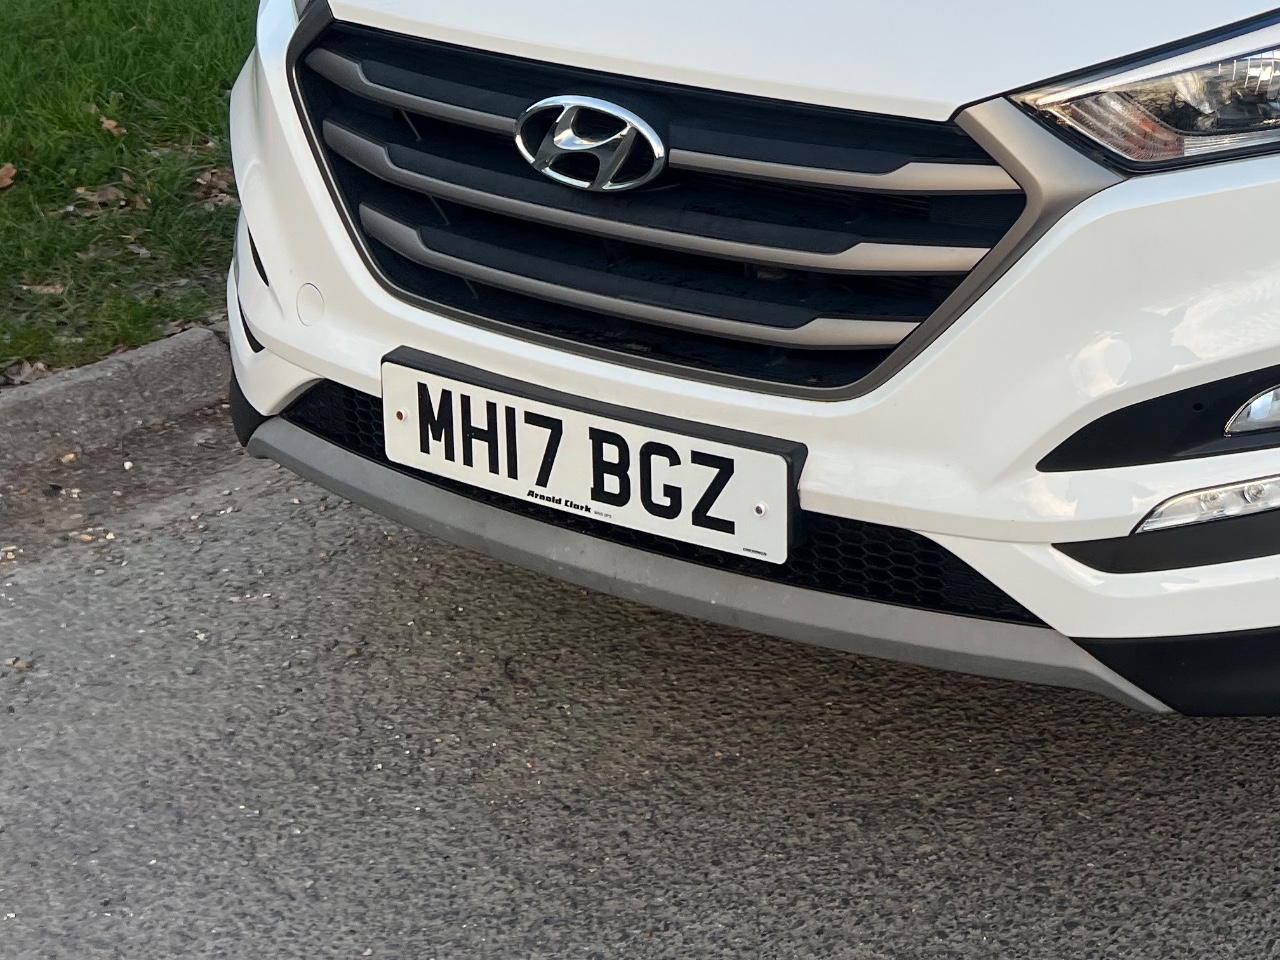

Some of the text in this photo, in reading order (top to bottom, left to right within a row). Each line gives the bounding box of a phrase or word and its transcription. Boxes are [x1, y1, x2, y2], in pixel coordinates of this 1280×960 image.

[417, 381, 736, 536] MH17 BGZ
[527, 489, 592, 513] Arnold Clark
